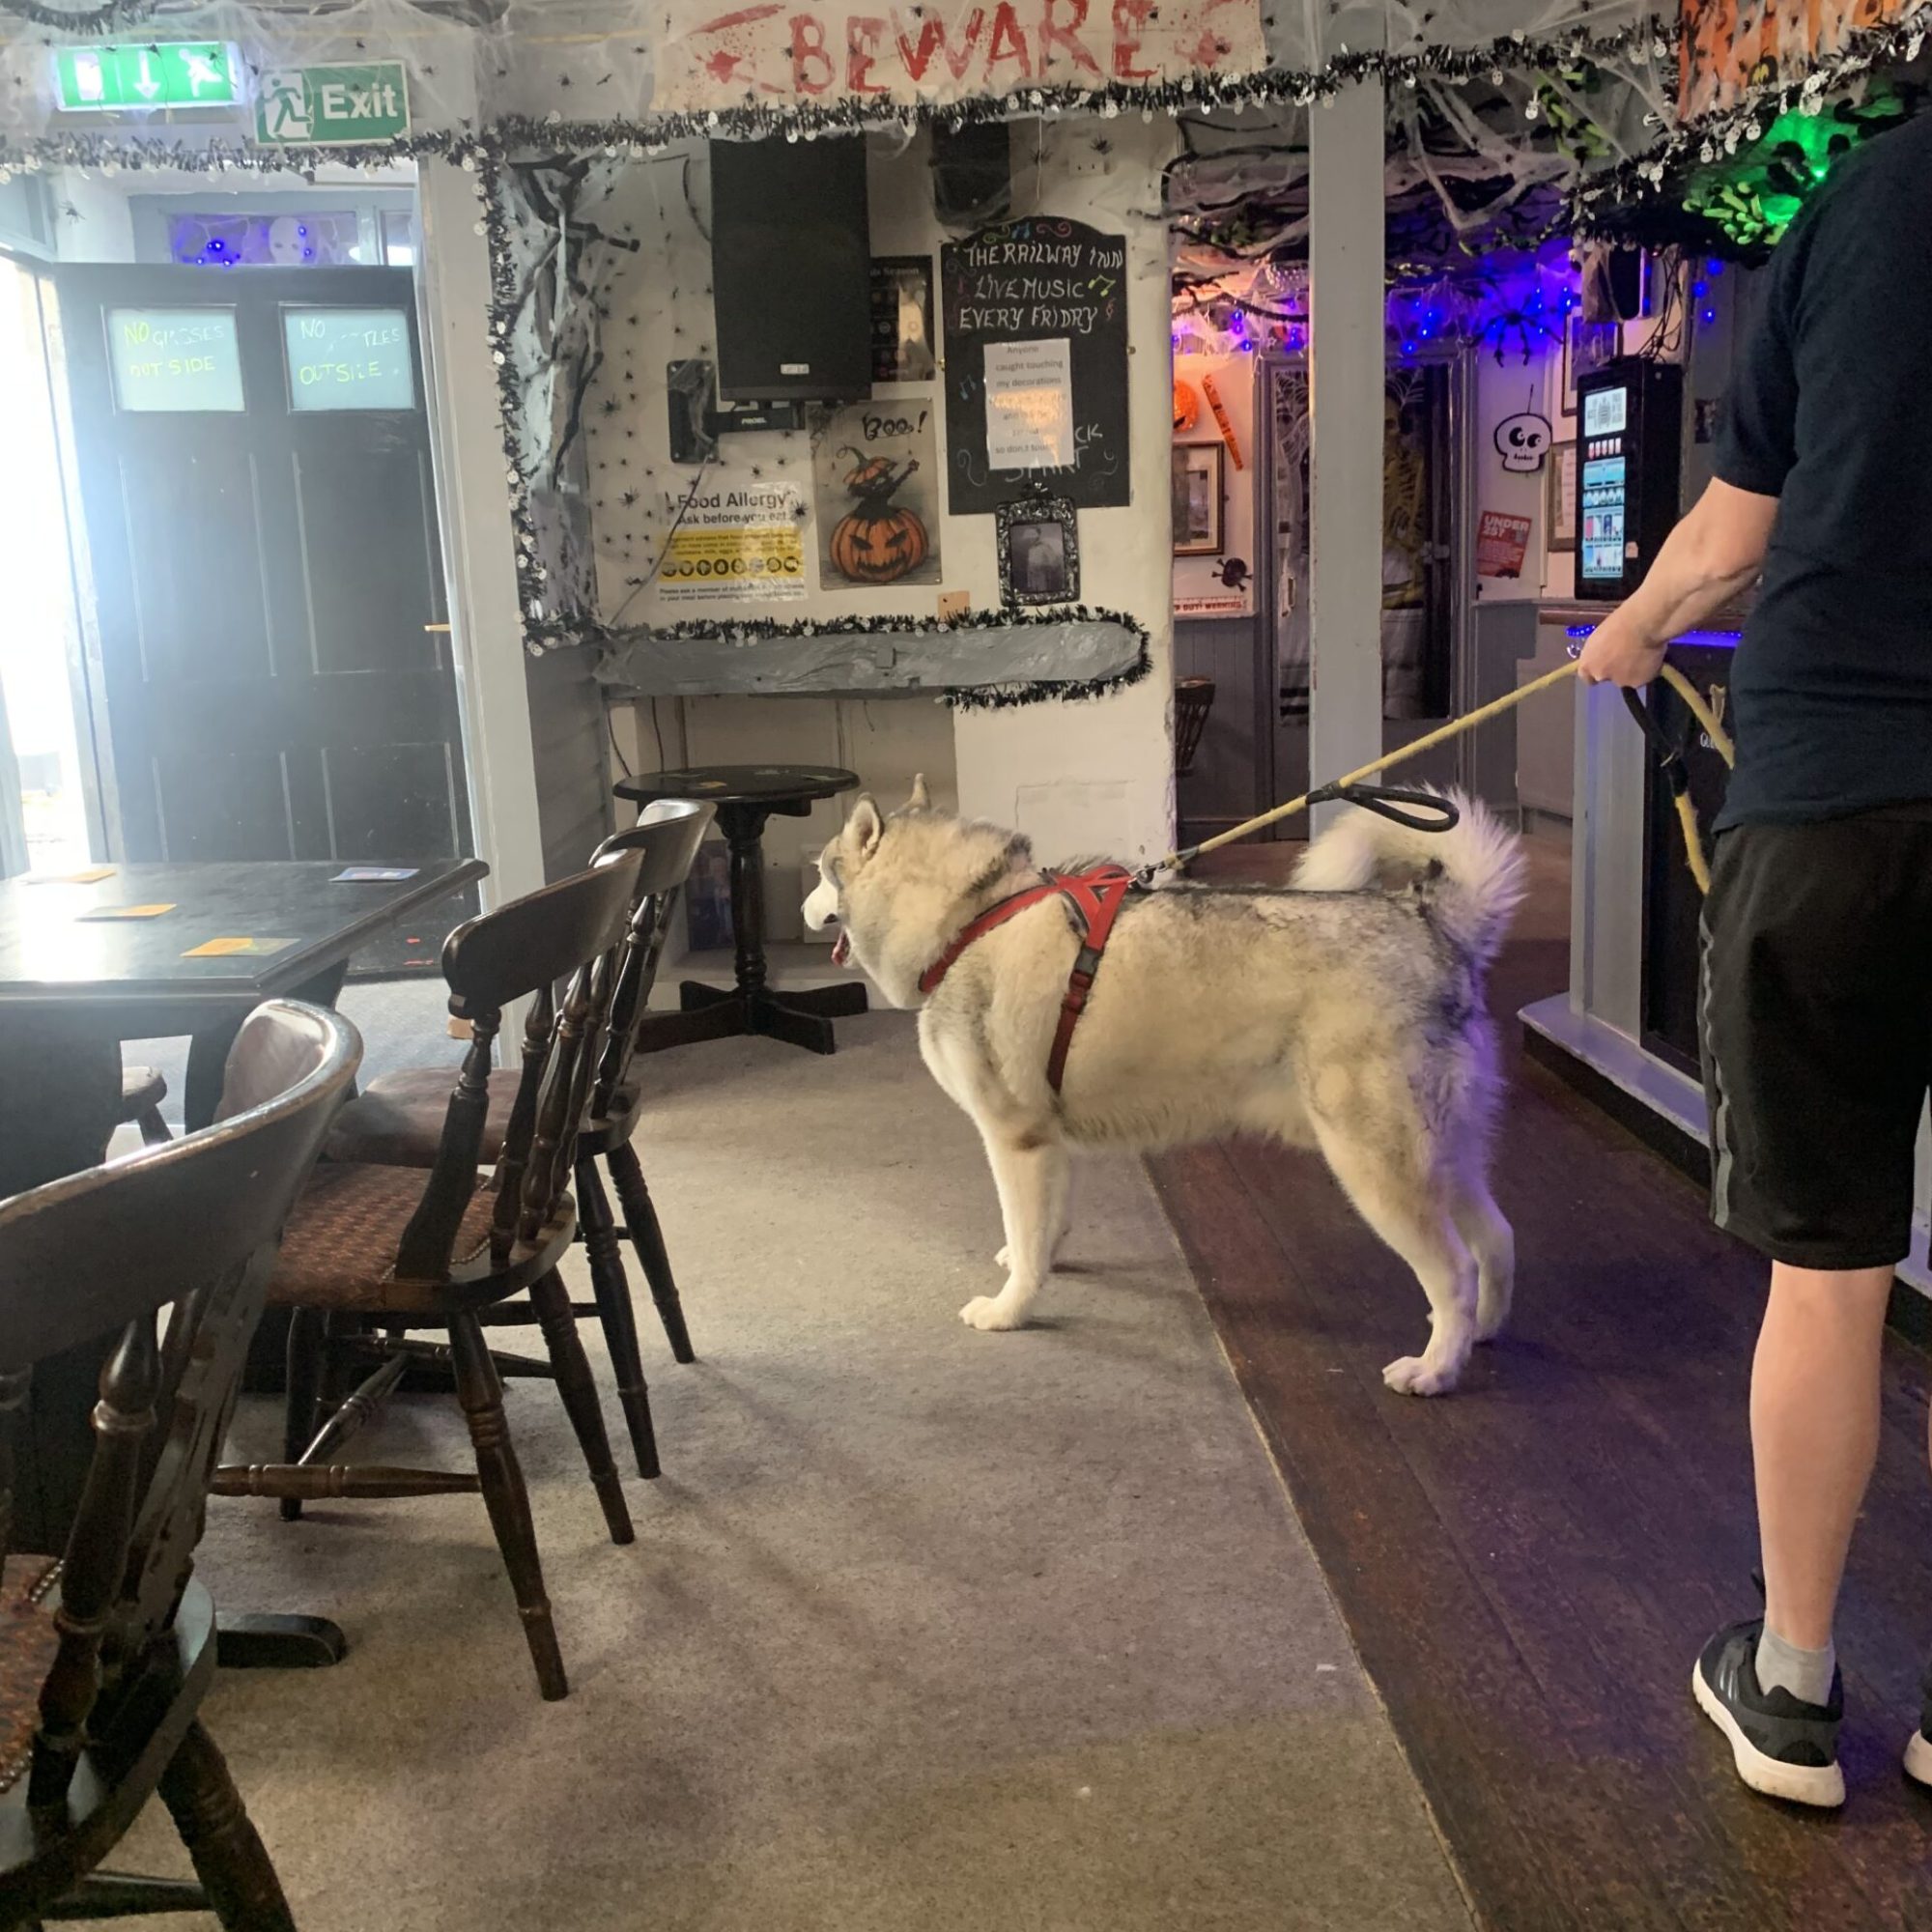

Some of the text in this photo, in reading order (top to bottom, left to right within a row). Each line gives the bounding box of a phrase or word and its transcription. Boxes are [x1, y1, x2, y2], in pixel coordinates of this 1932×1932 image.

[787, 0, 1159, 94] BEWARE
[322, 82, 398, 119] Exit
[963, 242, 999, 267] THE
[1089, 246, 1123, 270] INN
[1022, 277, 1085, 299] MUSIC
[300, 319, 326, 338] NO
[960, 306, 1024, 331] EVERY
[124, 322, 150, 346] NO
[995, 360, 1064, 372] caught touching
[1011, 377, 1062, 387] decorations
[677, 494, 721, 509] Food
[679, 514, 699, 525] Ask
[703, 513, 742, 524] before
[1485, 515, 1529, 531] UNDER
